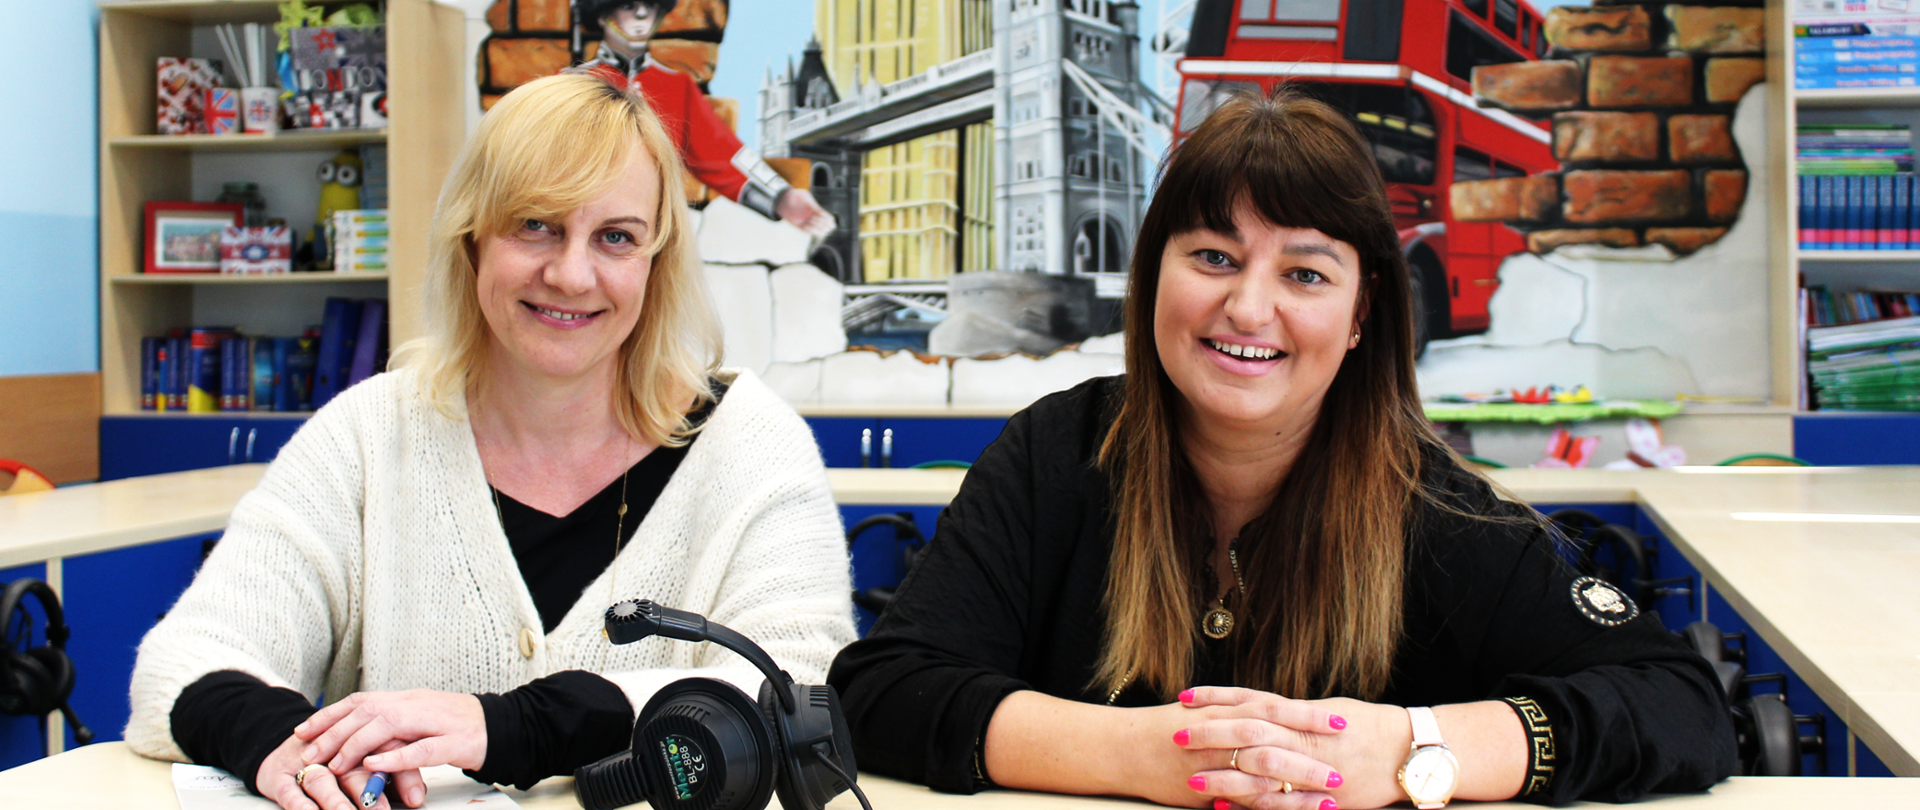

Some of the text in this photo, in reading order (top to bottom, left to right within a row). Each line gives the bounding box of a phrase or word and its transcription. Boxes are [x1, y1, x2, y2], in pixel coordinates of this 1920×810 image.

[298, 65, 386, 92] LONDO
[665, 736, 692, 800] Mentor
[679, 745, 698, 784] BL-888
